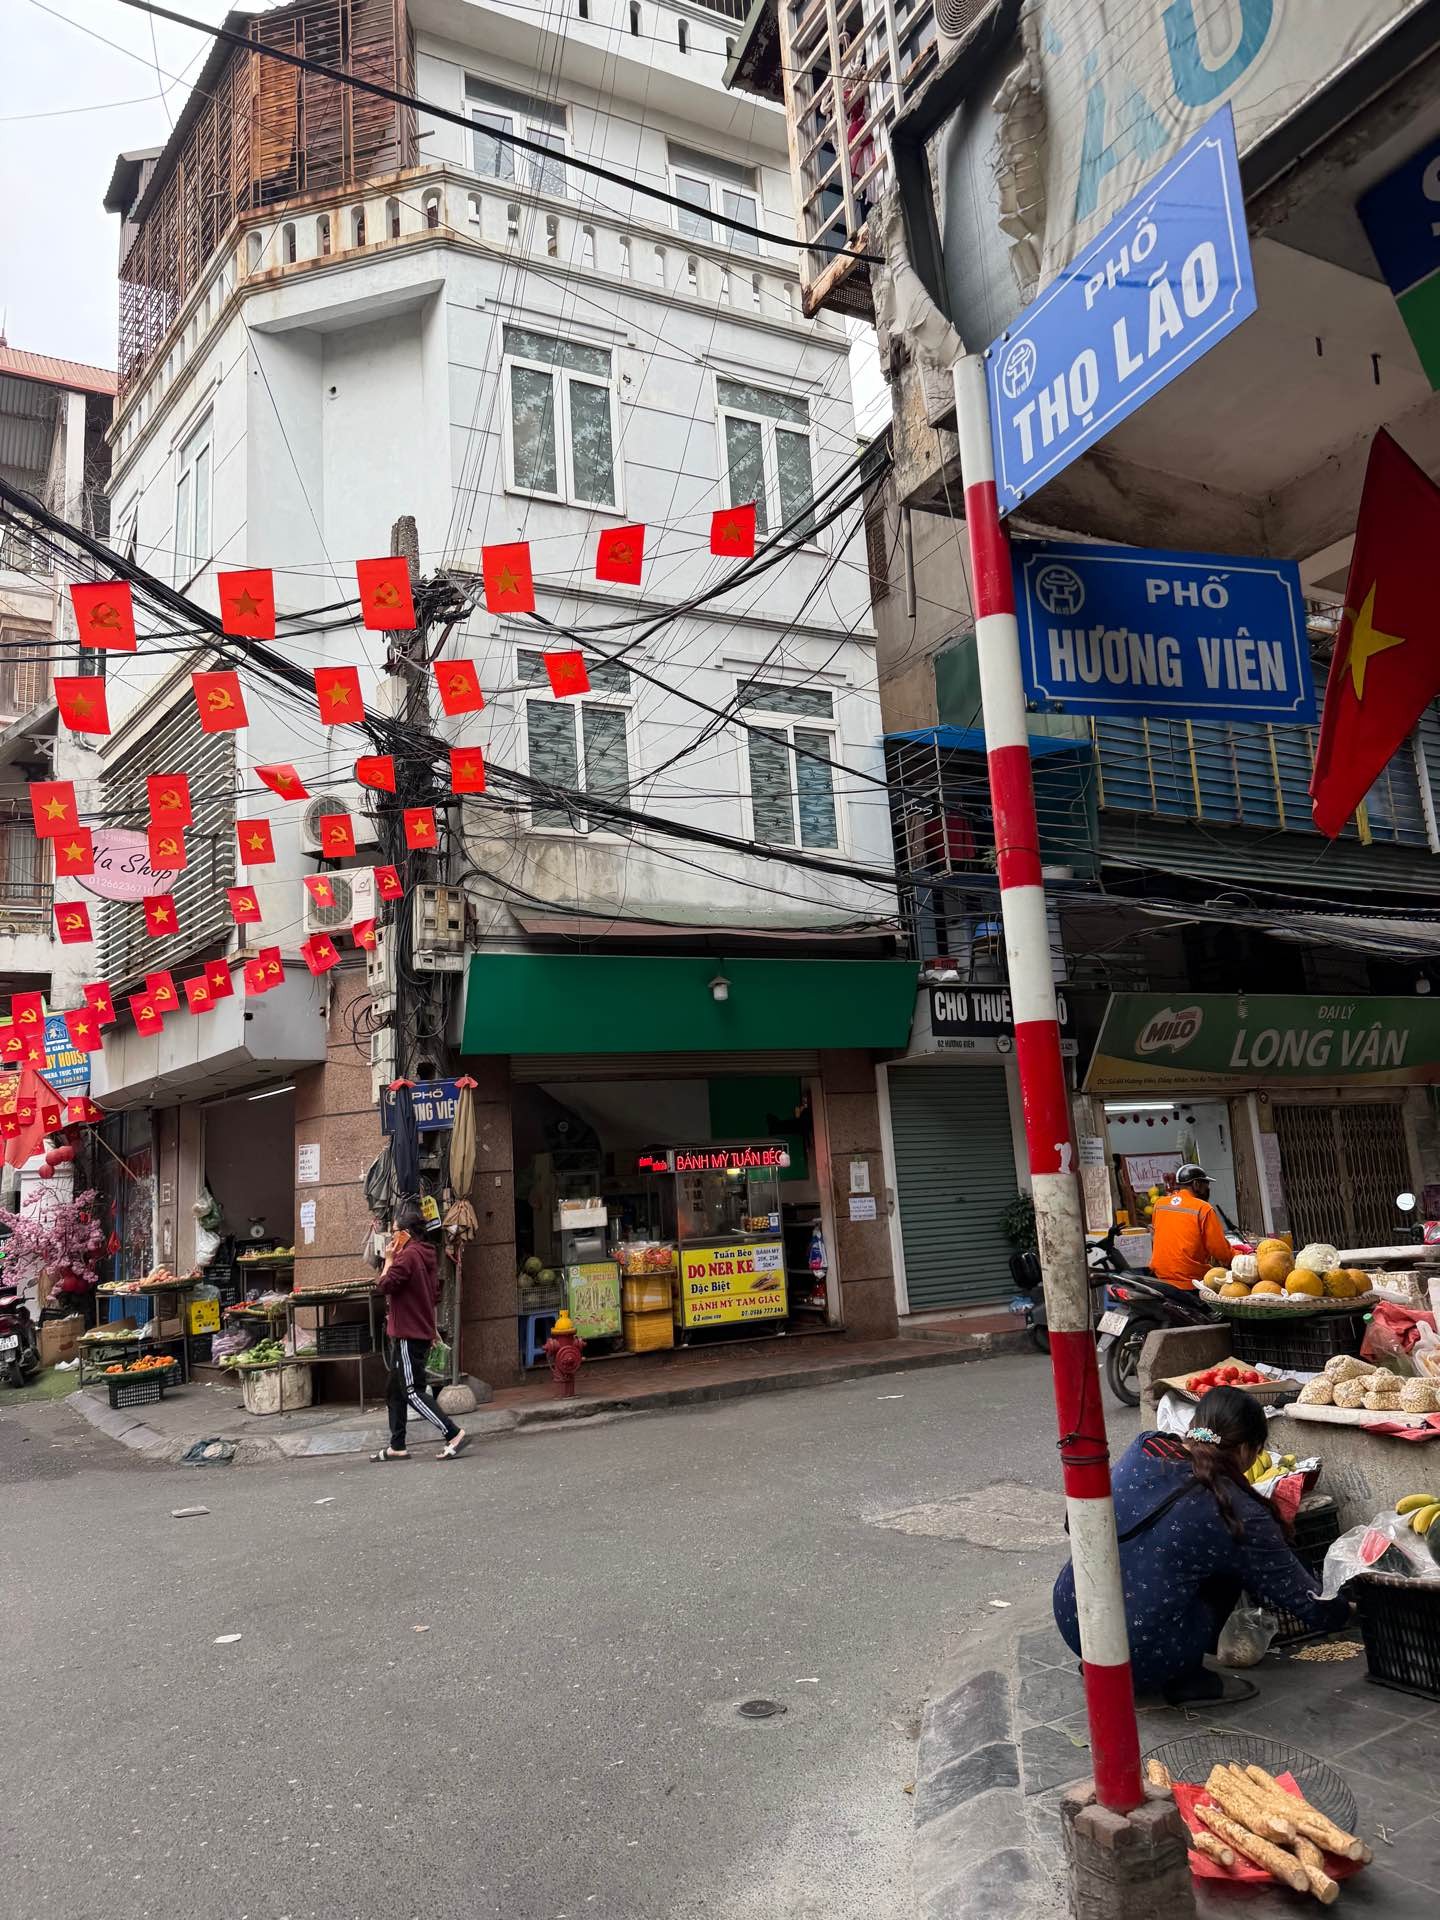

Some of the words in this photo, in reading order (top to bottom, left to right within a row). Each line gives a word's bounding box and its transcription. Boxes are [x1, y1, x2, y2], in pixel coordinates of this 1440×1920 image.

[1084, 200, 1158, 311] PHỐ
[1012, 349, 1099, 465] THỌ
[1112, 241, 1220, 383] LÃO
[1145, 573, 1231, 609] PHỐ
[1048, 625, 1184, 688] HƯƠNG
[1198, 626, 1288, 692] VIÊN
[934, 991, 968, 1022] CHO
[971, 989, 1012, 1023] THUÊ
[1317, 1005, 1341, 1023] ĐẠI
[1143, 1019, 1196, 1043] MILO
[1229, 1029, 1334, 1068] LONG
[1339, 1021, 1409, 1067] VÂN
[58, 1049, 88, 1068] HOUSE
[411, 1087, 444, 1100] PHỐ
[676, 1152, 709, 1170] BÁNH
[731, 1147, 760, 1167] TUẤN
[687, 1263, 706, 1279] DO
[708, 1260, 734, 1277] NER
[690, 1283, 709, 1295] Đặc
[711, 1280, 731, 1292] Biệt
[691, 1299, 718, 1312] BÁNH
[736, 1297, 756, 1307] TAM
[758, 1293, 781, 1305] GIÁC
